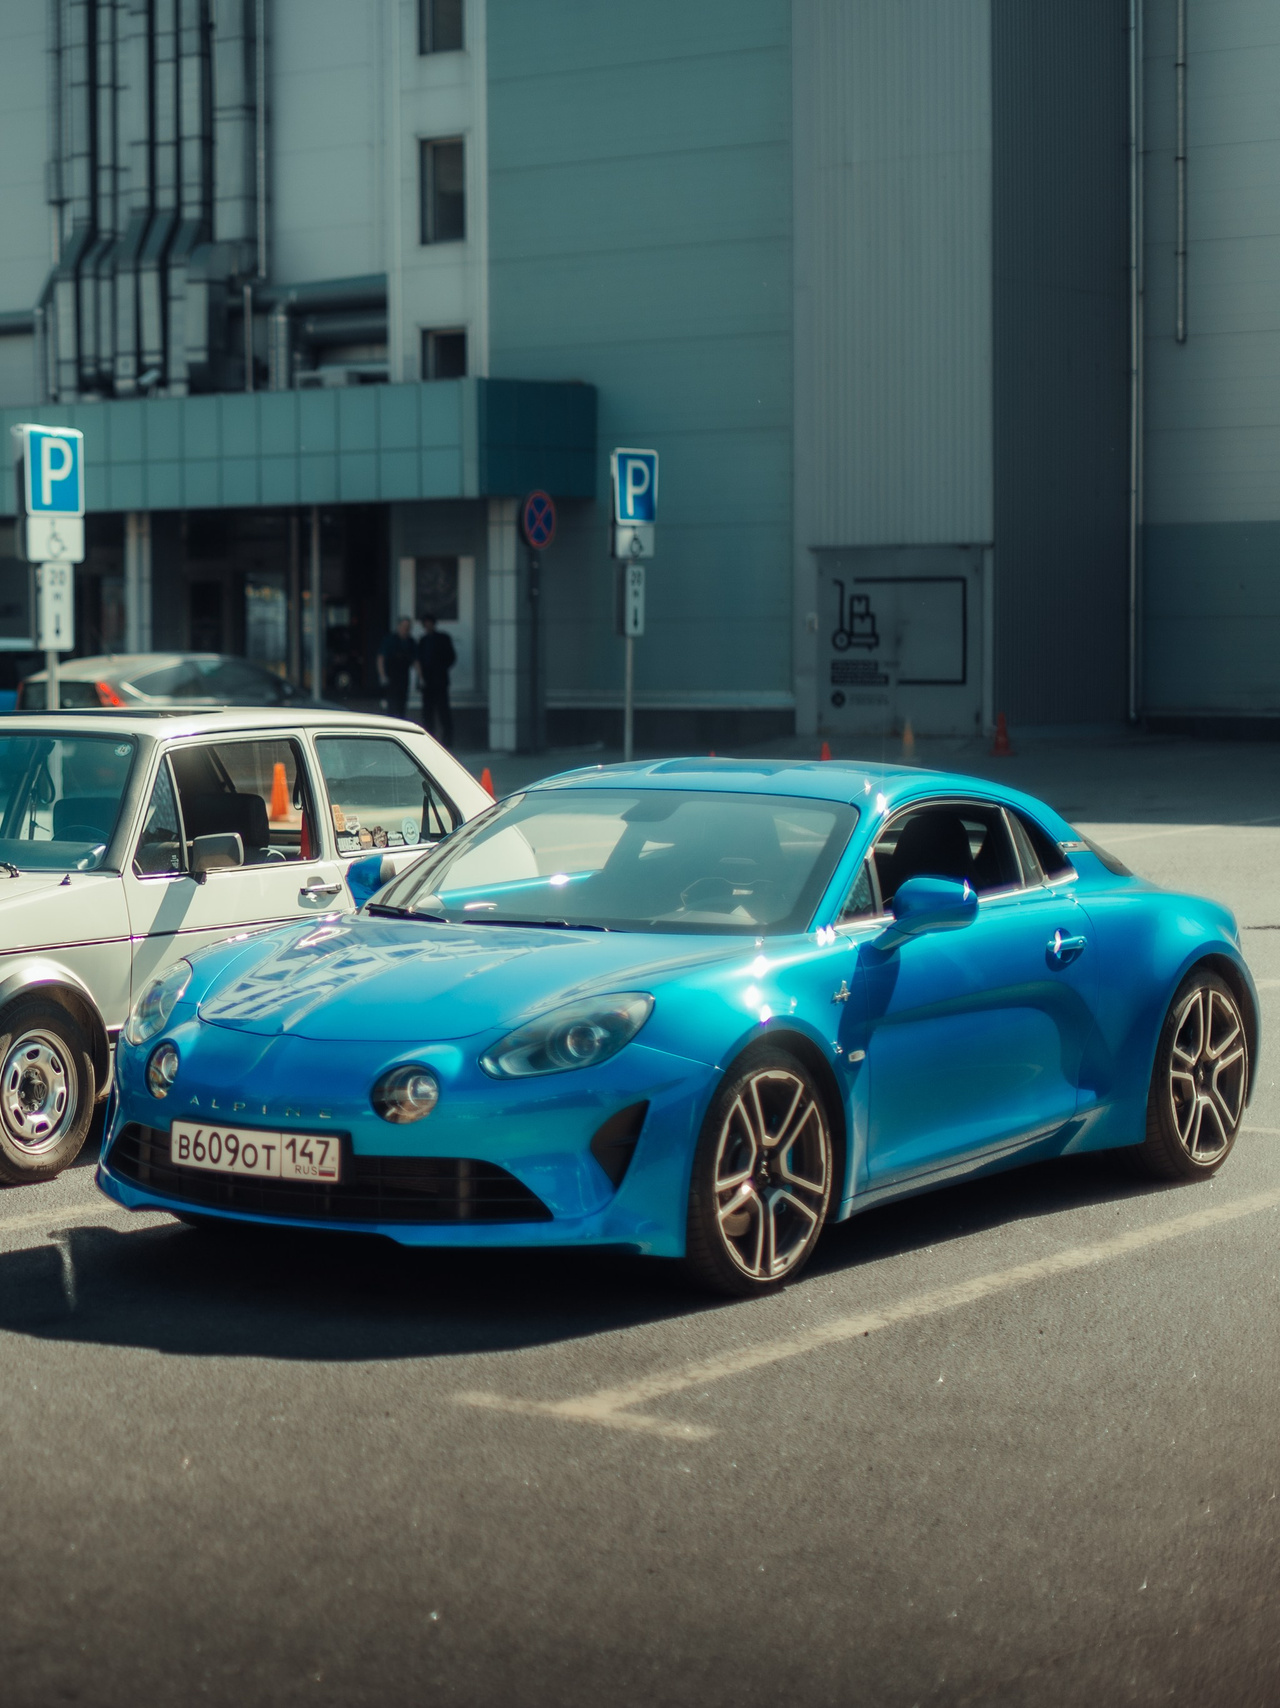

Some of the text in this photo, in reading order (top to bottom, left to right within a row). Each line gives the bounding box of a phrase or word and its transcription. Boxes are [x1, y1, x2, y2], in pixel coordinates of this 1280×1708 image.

[41, 437, 74, 506] P
[626, 459, 650, 517] P
[189, 1095, 332, 1119] ALPINE
[285, 1137, 330, 1166] 147
[295, 1165, 318, 1176] RUS
